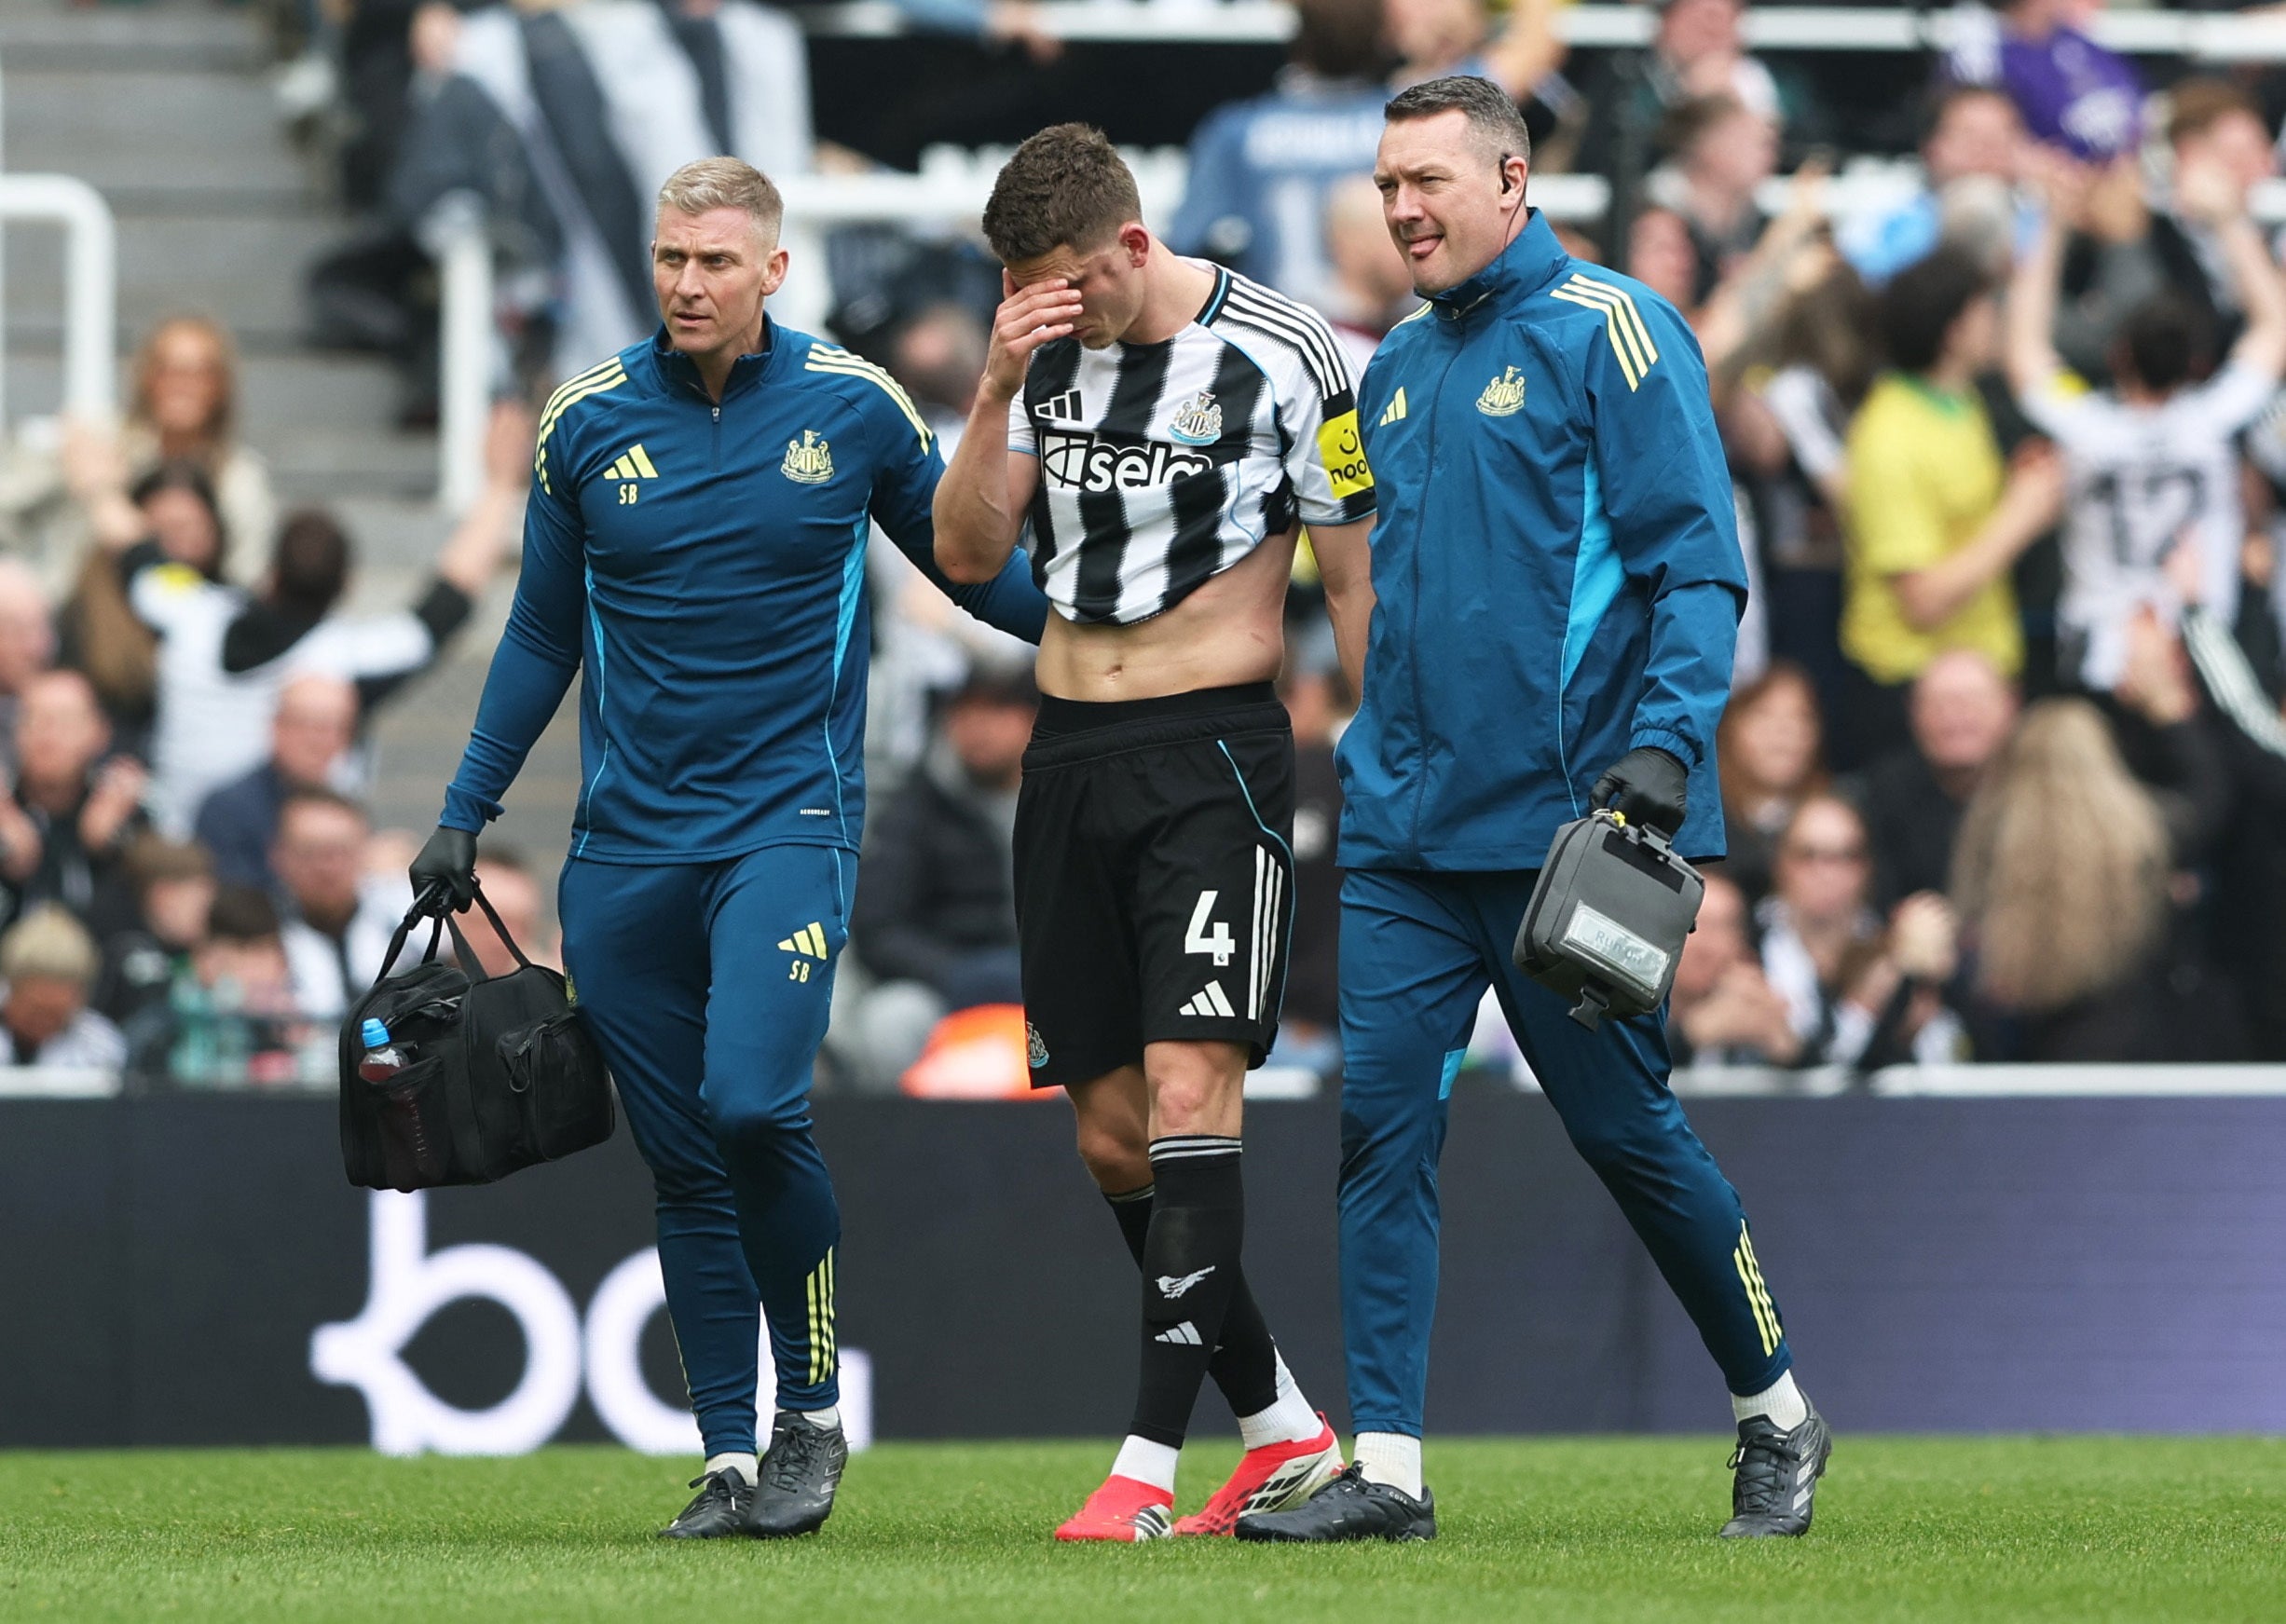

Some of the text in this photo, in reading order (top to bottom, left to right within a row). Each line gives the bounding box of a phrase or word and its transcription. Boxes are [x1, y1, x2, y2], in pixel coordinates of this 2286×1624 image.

[619, 484, 637, 505] SB
[1184, 890, 1236, 966] 4
[788, 960, 810, 983] SB
